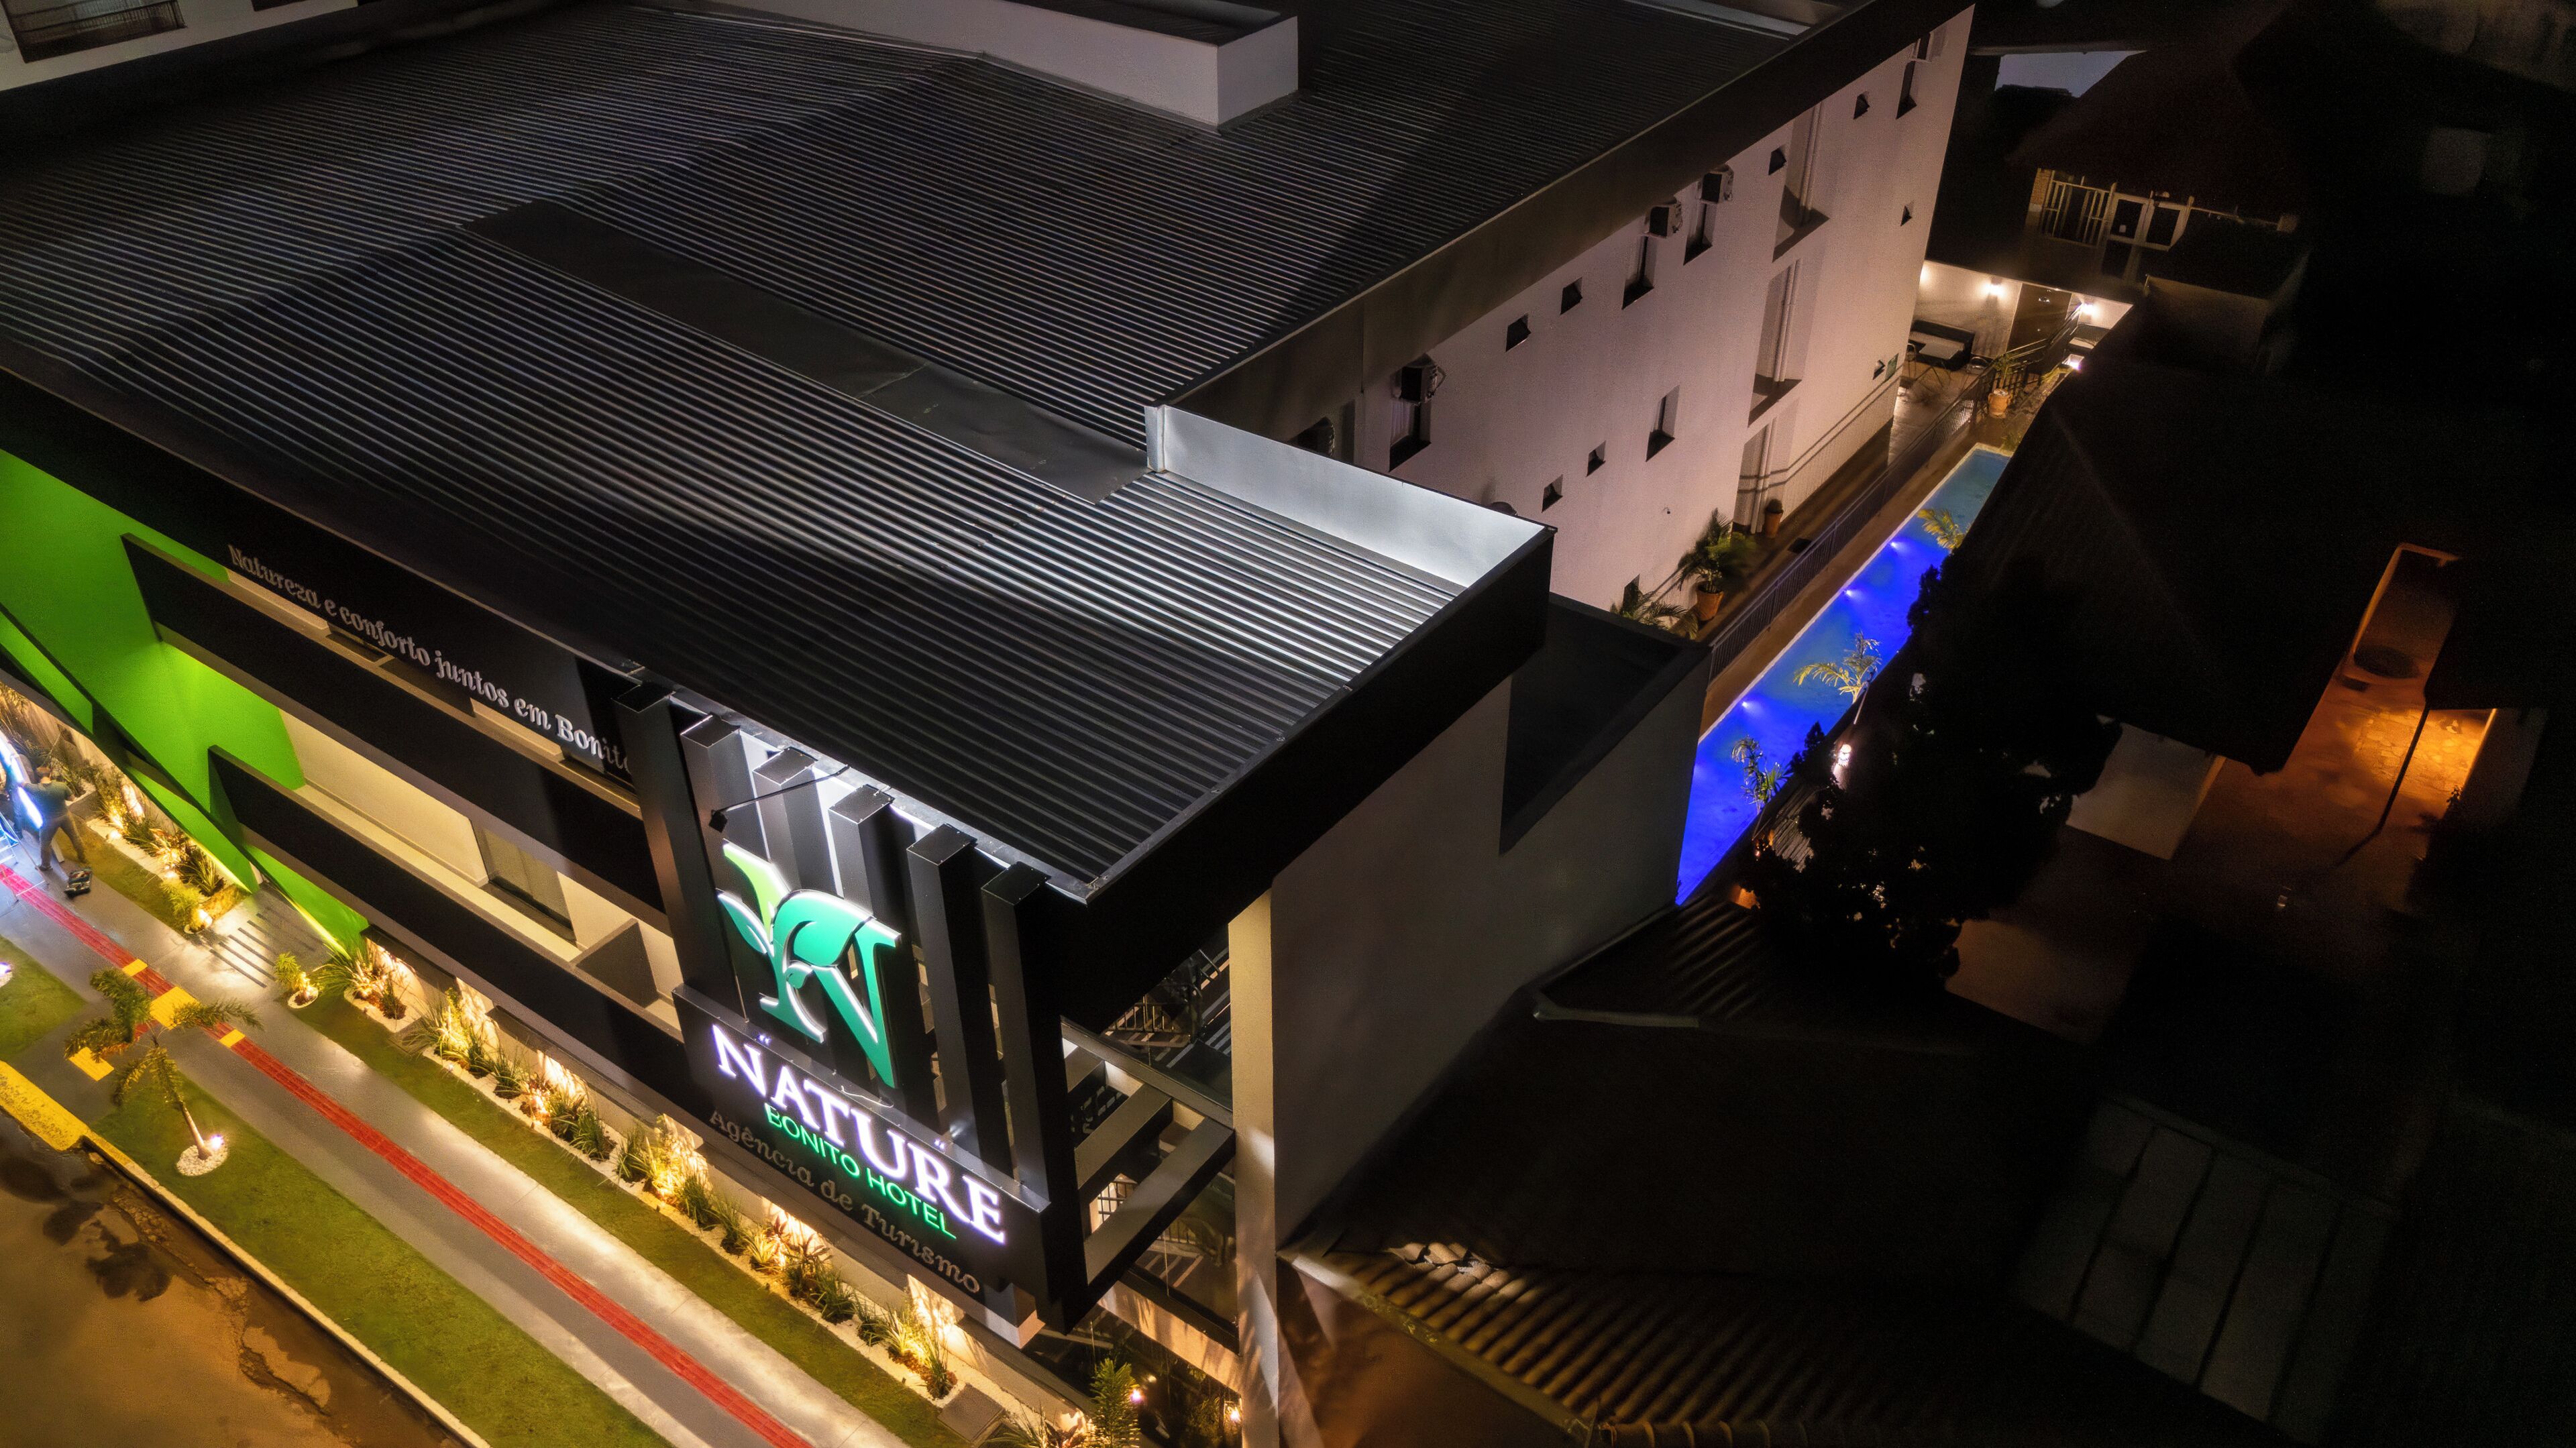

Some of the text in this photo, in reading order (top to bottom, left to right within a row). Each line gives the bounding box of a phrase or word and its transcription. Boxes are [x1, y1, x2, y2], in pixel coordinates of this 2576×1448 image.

[228, 544, 321, 608] Natureza
[324, 599, 337, 616] e
[435, 650, 510, 708] juntos
[514, 698, 551, 730] em
[711, 1023, 1006, 1245] NATURE
[764, 1102, 957, 1239] BONITO HOTEL
[820, 1179, 853, 1211] de
